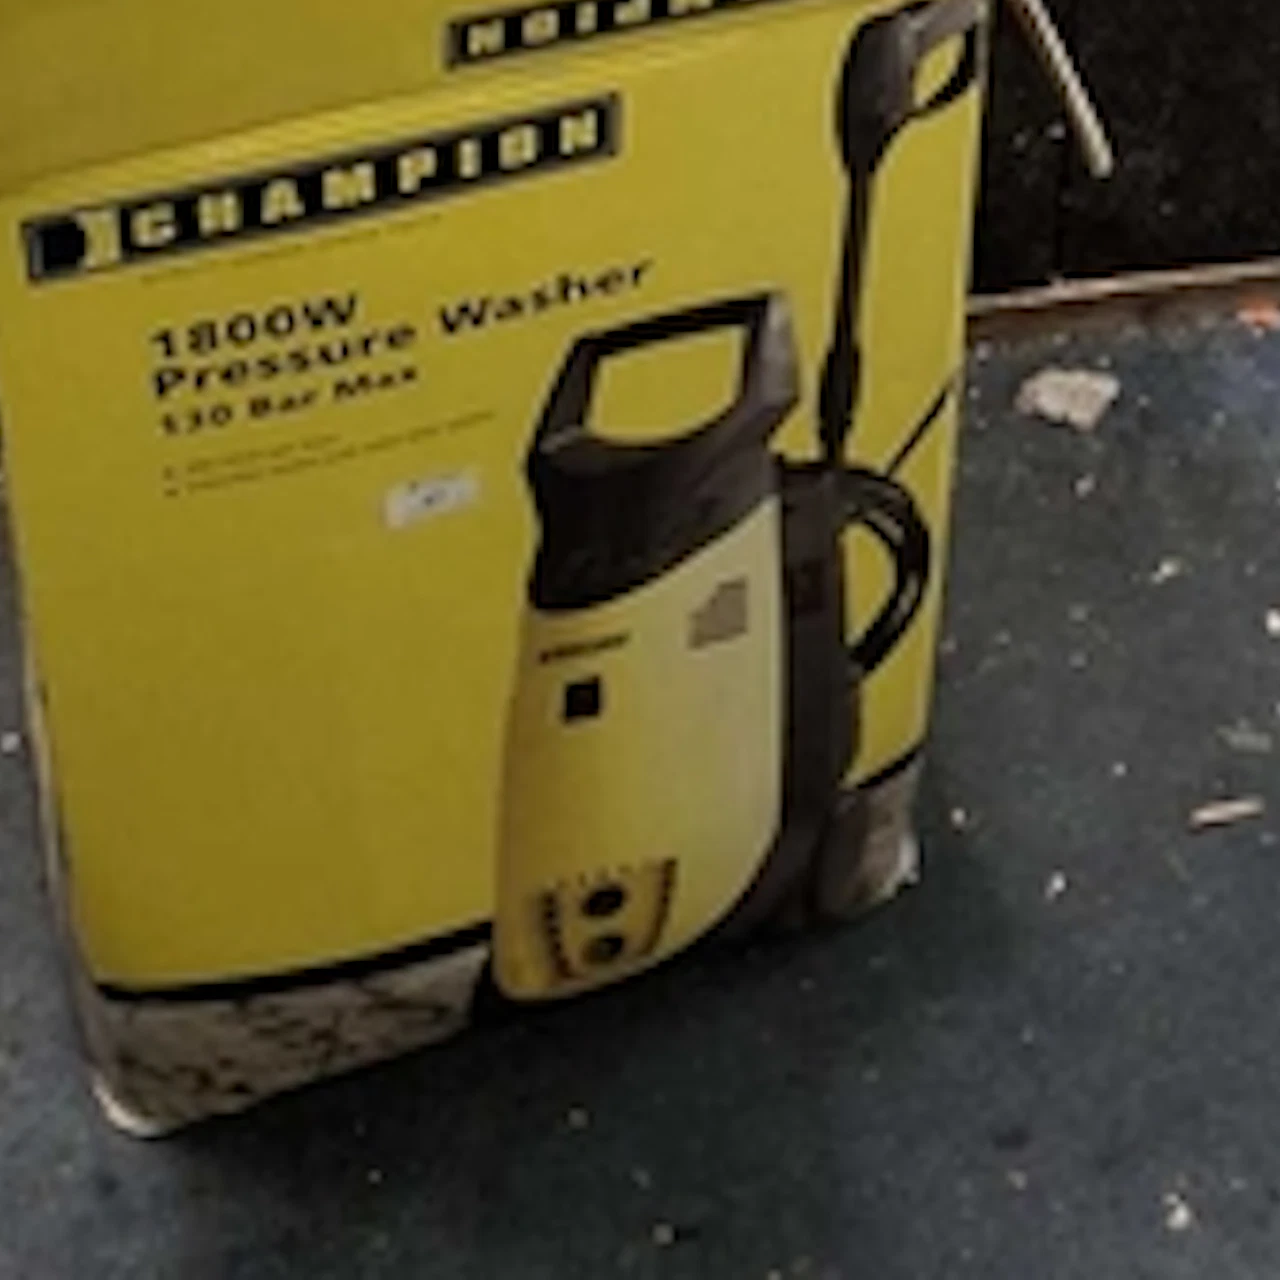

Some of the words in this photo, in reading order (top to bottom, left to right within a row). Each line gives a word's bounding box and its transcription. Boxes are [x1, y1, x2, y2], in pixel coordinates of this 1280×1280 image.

[131, 109, 599, 249] CHAMPION
[150, 292, 358, 361] 1800W
[153, 324, 417, 399] Pressure
[437, 257, 654, 336] Washer
[248, 388, 316, 418] Bar
[332, 366, 417, 402] Max
